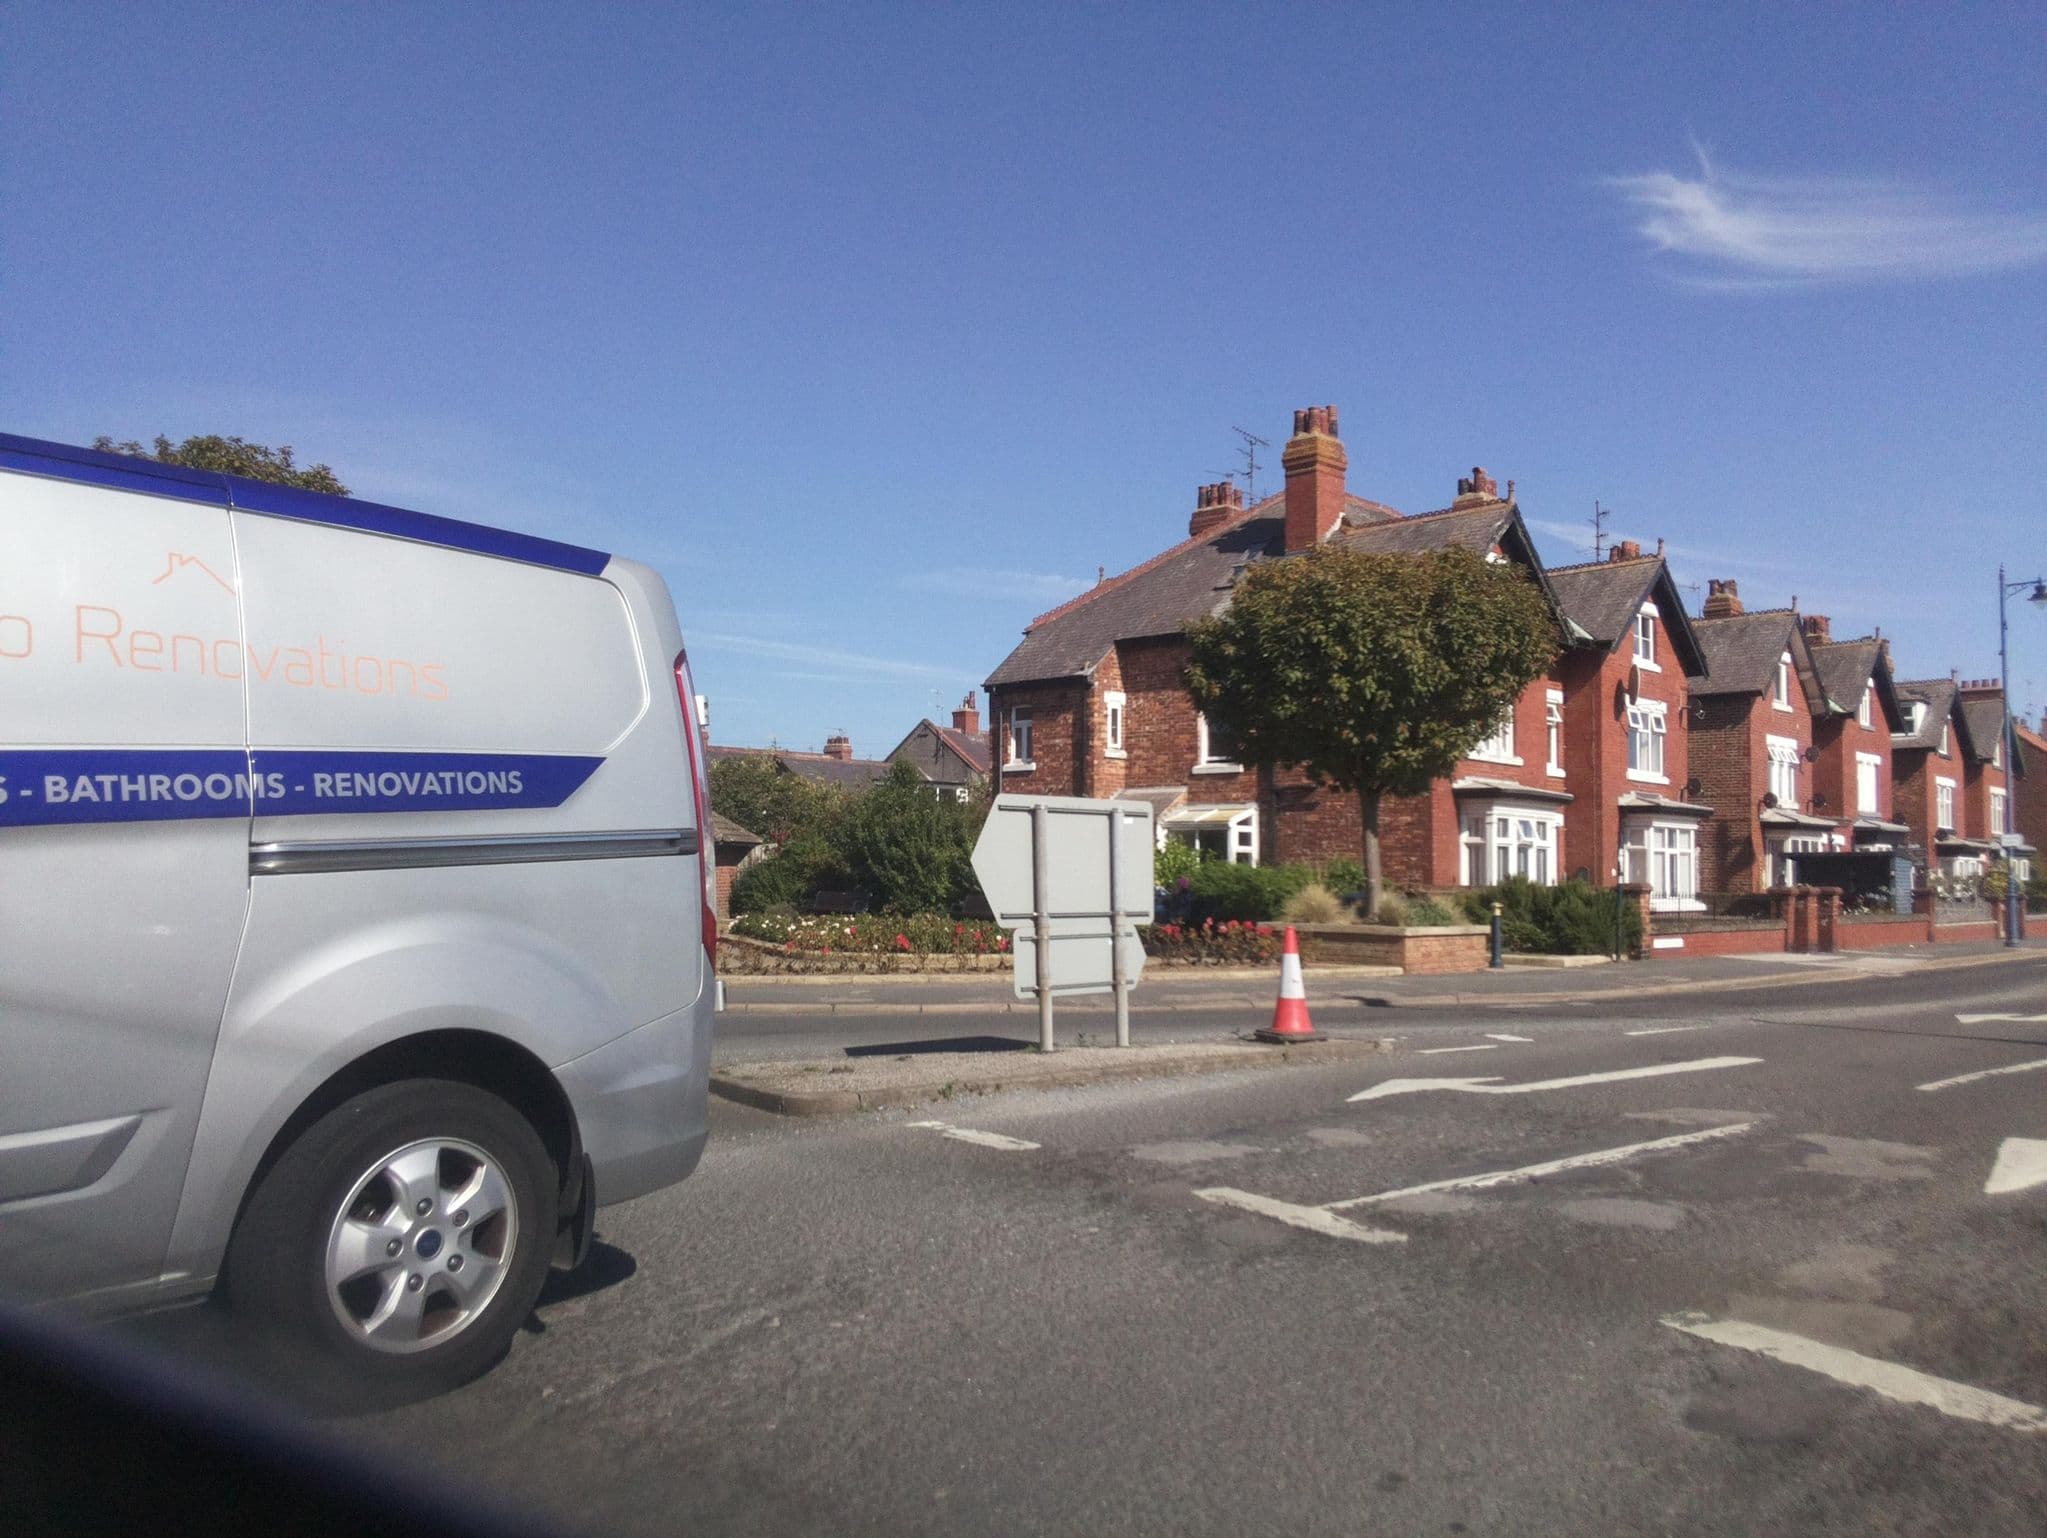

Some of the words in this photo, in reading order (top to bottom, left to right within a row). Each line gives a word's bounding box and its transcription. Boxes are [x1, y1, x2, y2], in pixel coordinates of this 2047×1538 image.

[75, 604, 449, 701] Renovations
[44, 773, 287, 803] BATHROOMS
[313, 771, 524, 798] RENOVATIONS
